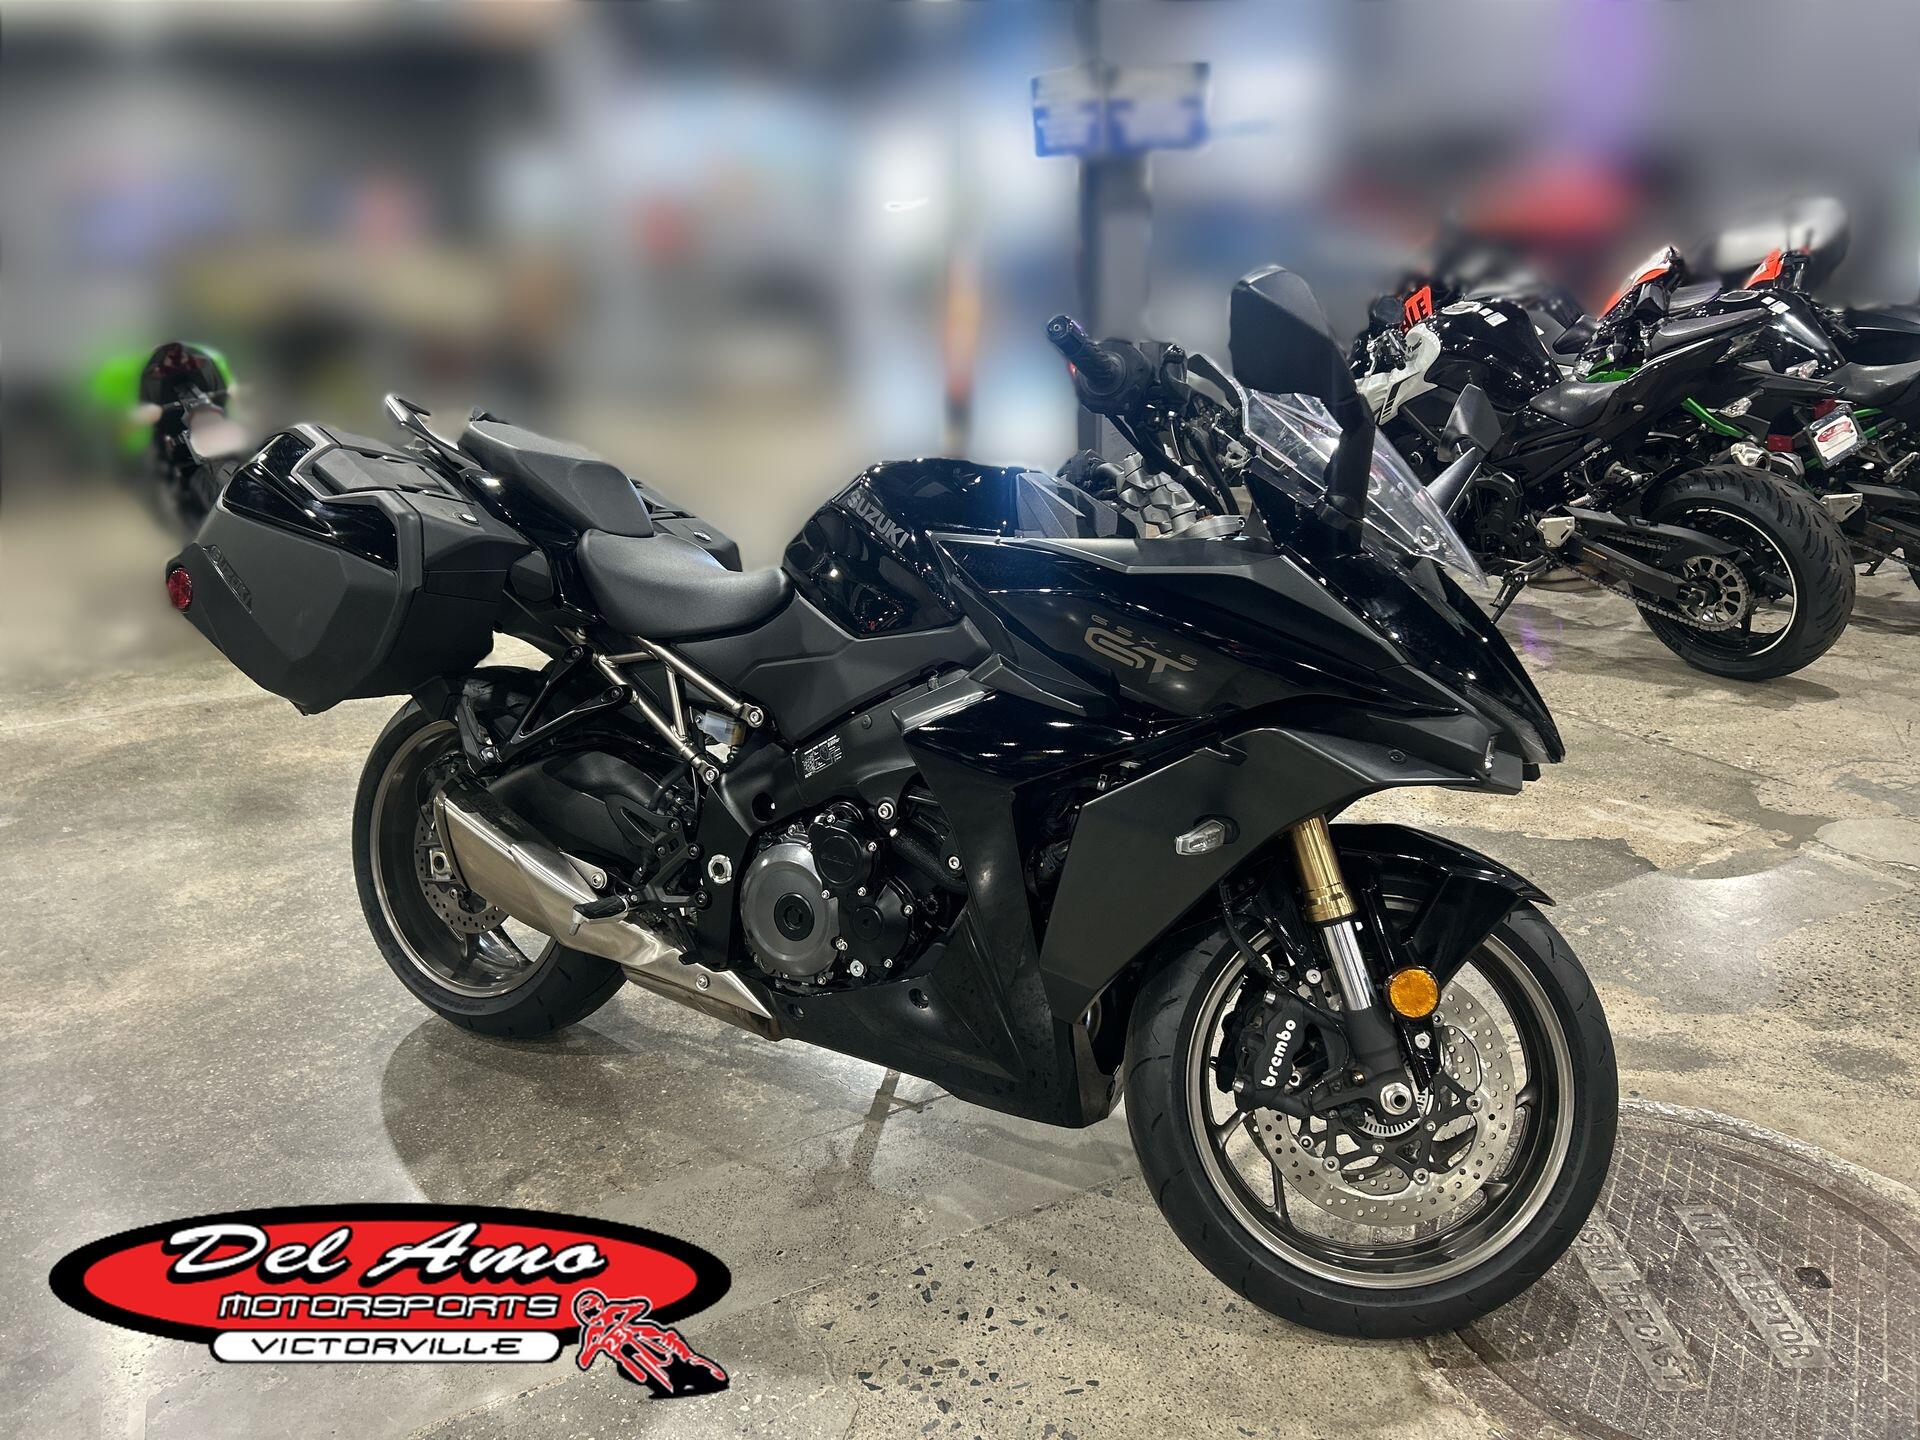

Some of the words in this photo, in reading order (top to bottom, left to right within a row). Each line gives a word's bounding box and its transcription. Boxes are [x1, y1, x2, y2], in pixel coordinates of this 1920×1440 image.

[847, 489, 909, 548] SUZUKI
[1261, 1020, 1296, 1087] brembo
[1689, 1212, 1814, 1358] INTERCEPTOR
